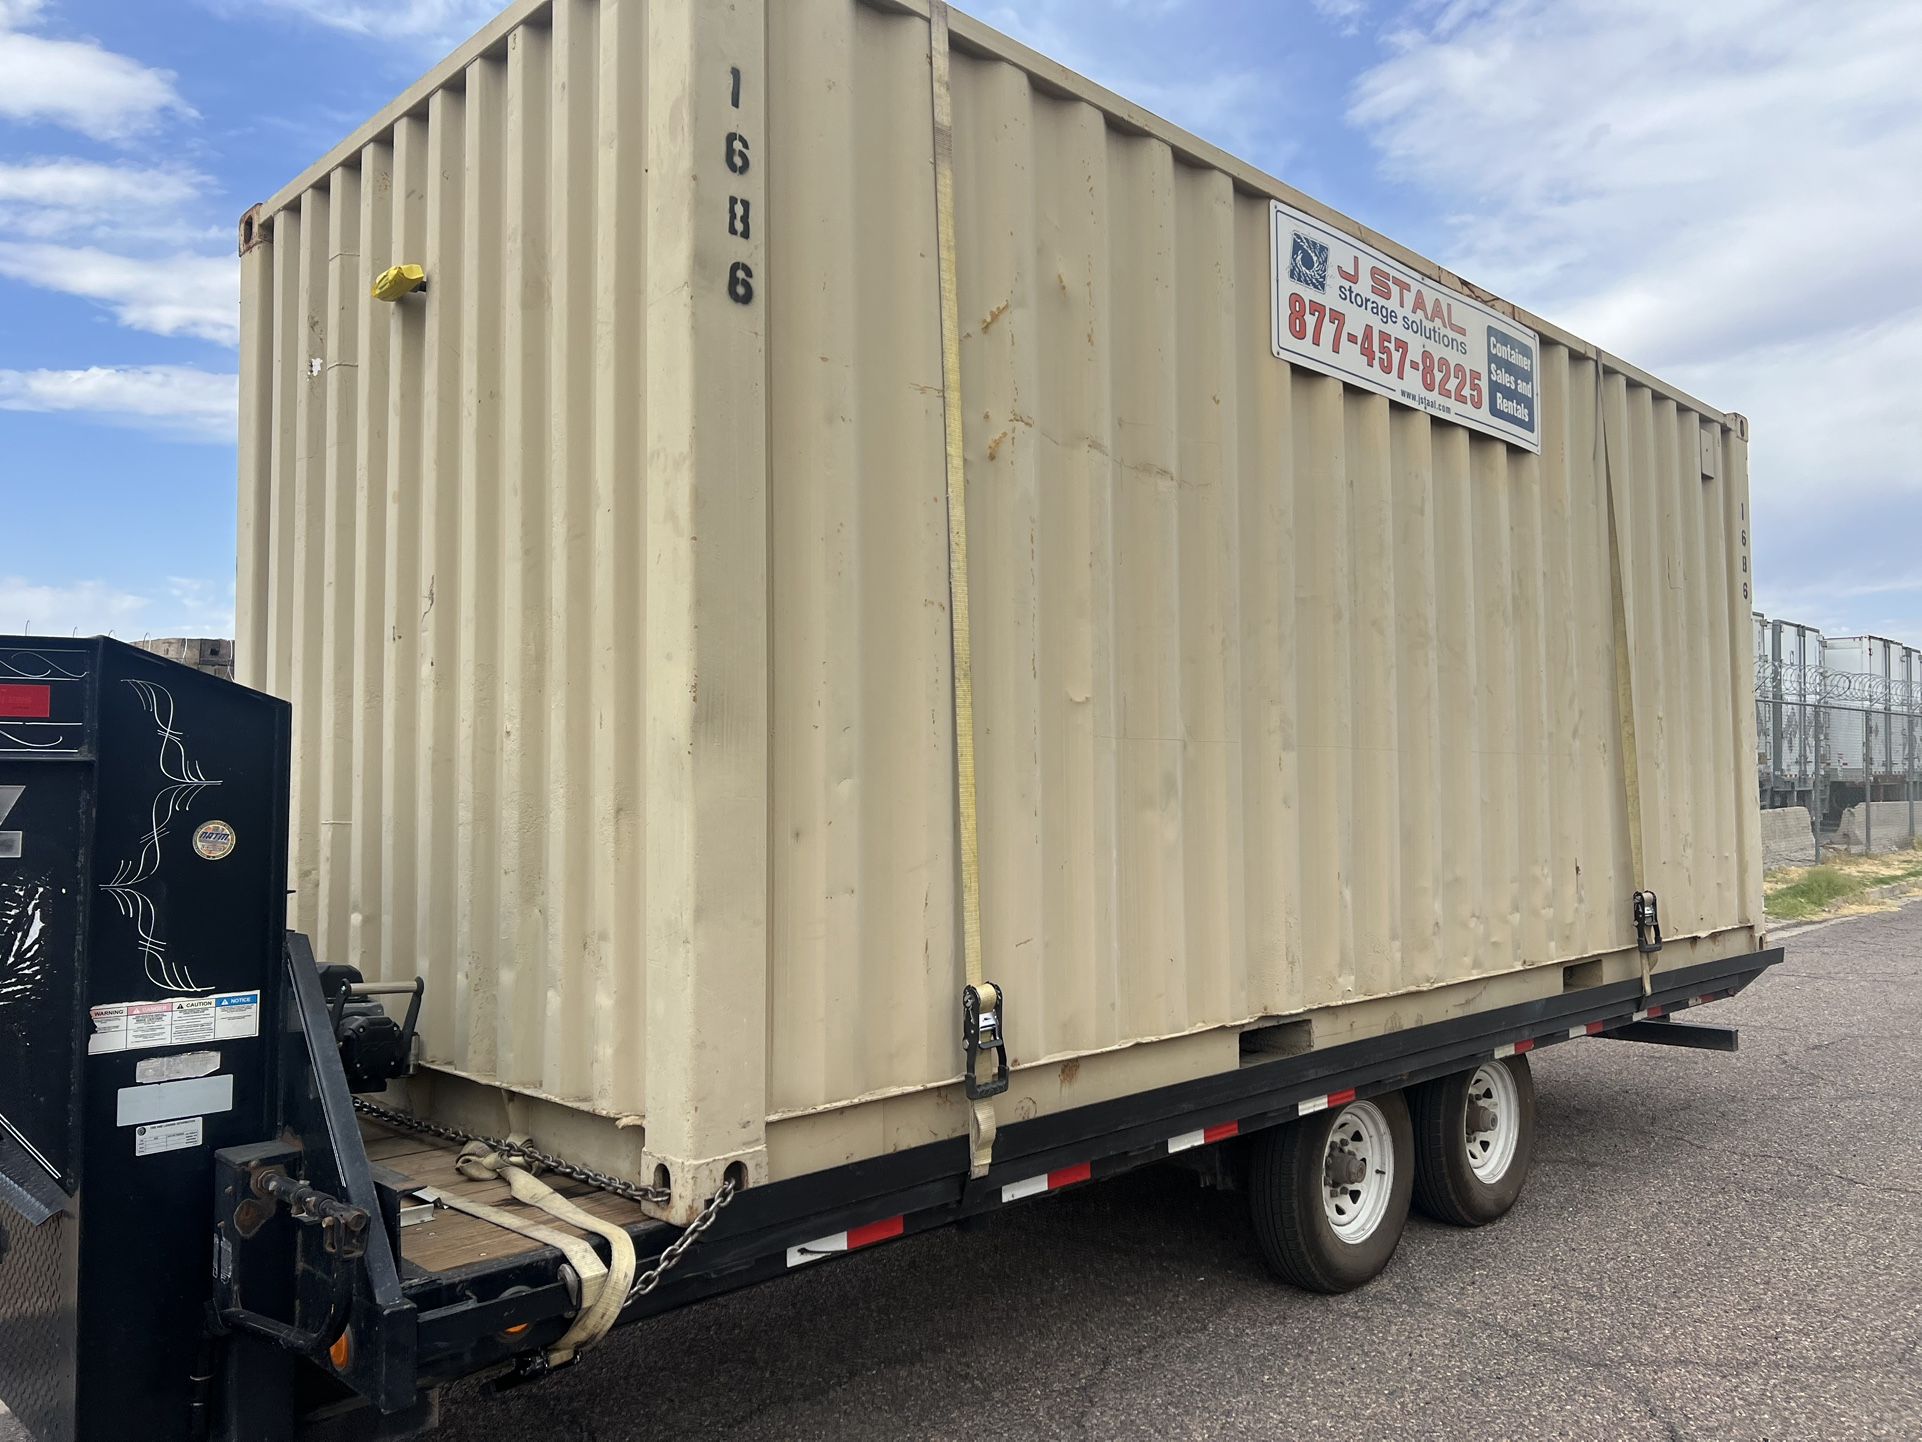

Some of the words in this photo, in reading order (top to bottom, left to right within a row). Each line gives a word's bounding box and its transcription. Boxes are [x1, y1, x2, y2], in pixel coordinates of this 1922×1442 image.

[726, 66, 754, 305] 1686
[1337, 255, 1359, 285] J
[1370, 266, 1467, 337] STAAL
[1338, 284, 1398, 325] storage
[1402, 315, 1468, 355] solutions
[1288, 292, 1483, 410] 877-457-8225
[1490, 336, 1532, 371] Container
[1490, 364, 1515, 390] Sales
[1517, 376, 1532, 398] and
[1400, 389, 1452, 415] www.jstaal.com
[1496, 392, 1529, 423] Rentals
[94, 1009, 124, 1017] WARNING
[185, 1000, 213, 1009] CAUTION
